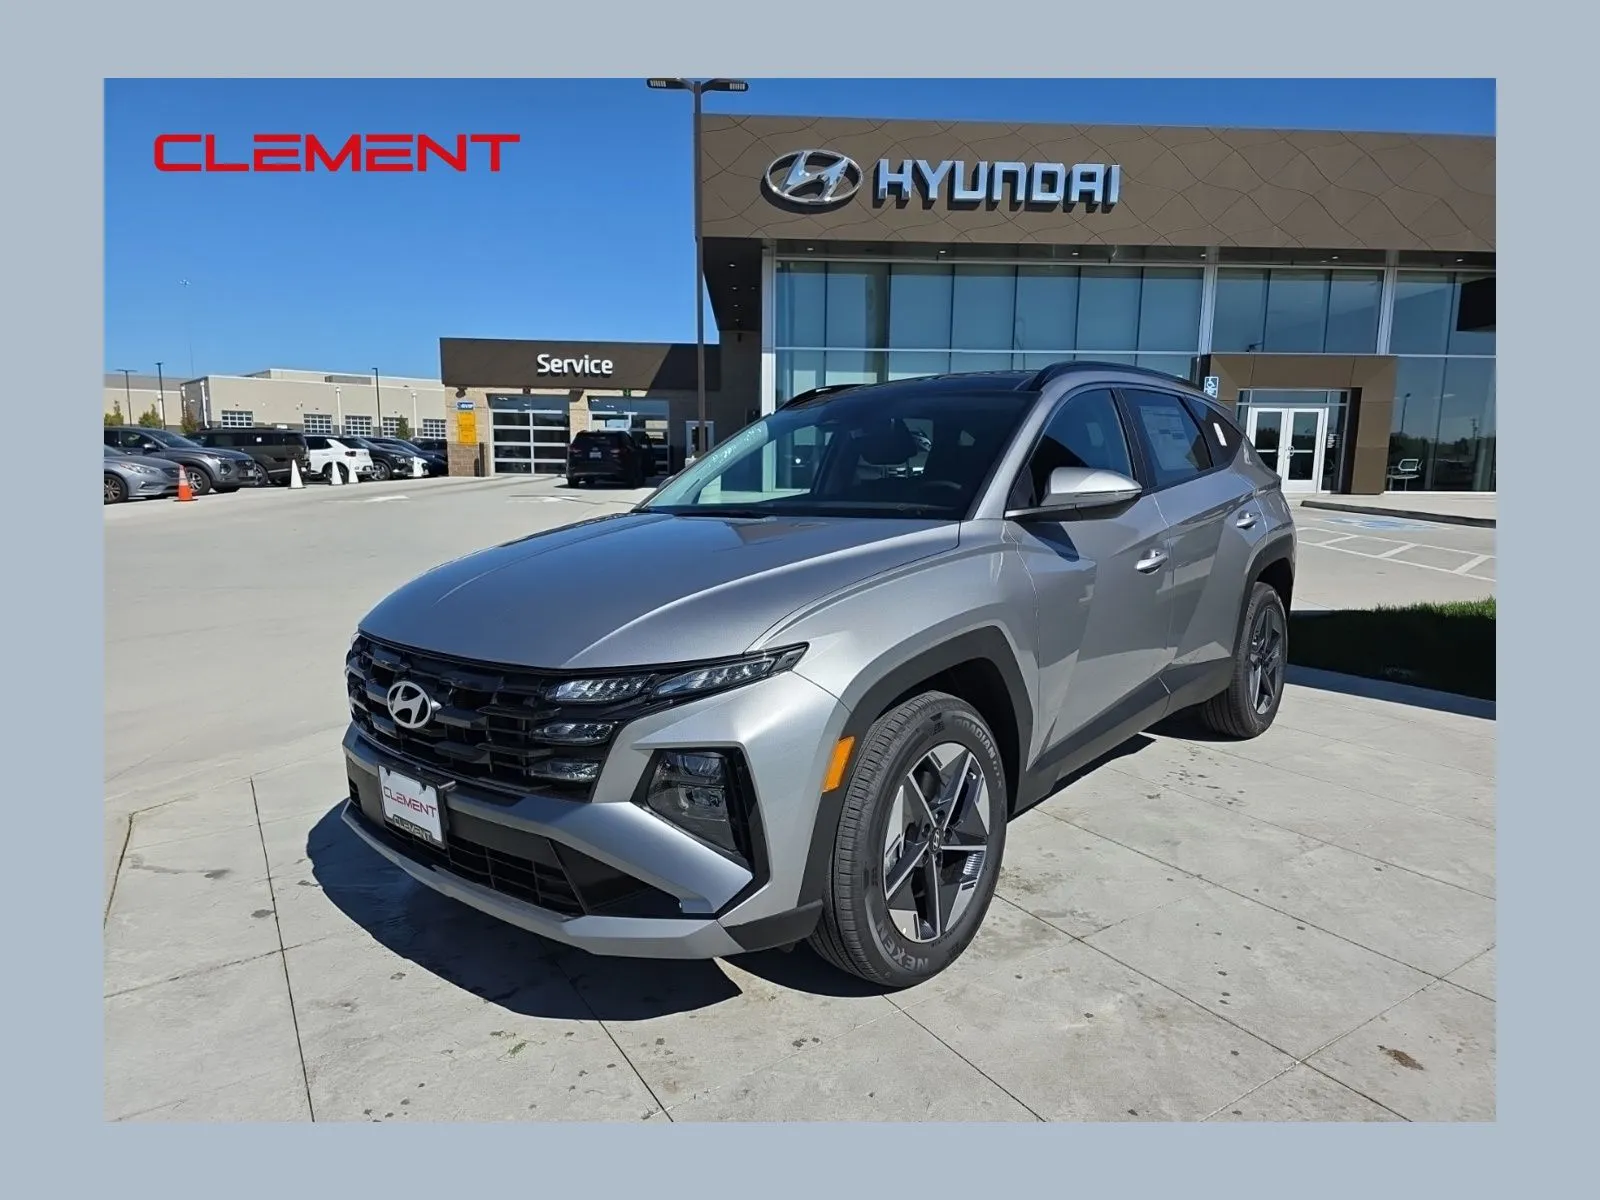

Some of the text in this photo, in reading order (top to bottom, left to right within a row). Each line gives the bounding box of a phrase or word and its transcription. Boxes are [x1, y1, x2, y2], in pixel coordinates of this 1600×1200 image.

[876, 158, 1121, 206] HYUNDAI
[536, 353, 614, 375] Service
[383, 785, 437, 818] CLEMENT
[875, 920, 929, 972] NEXEN
